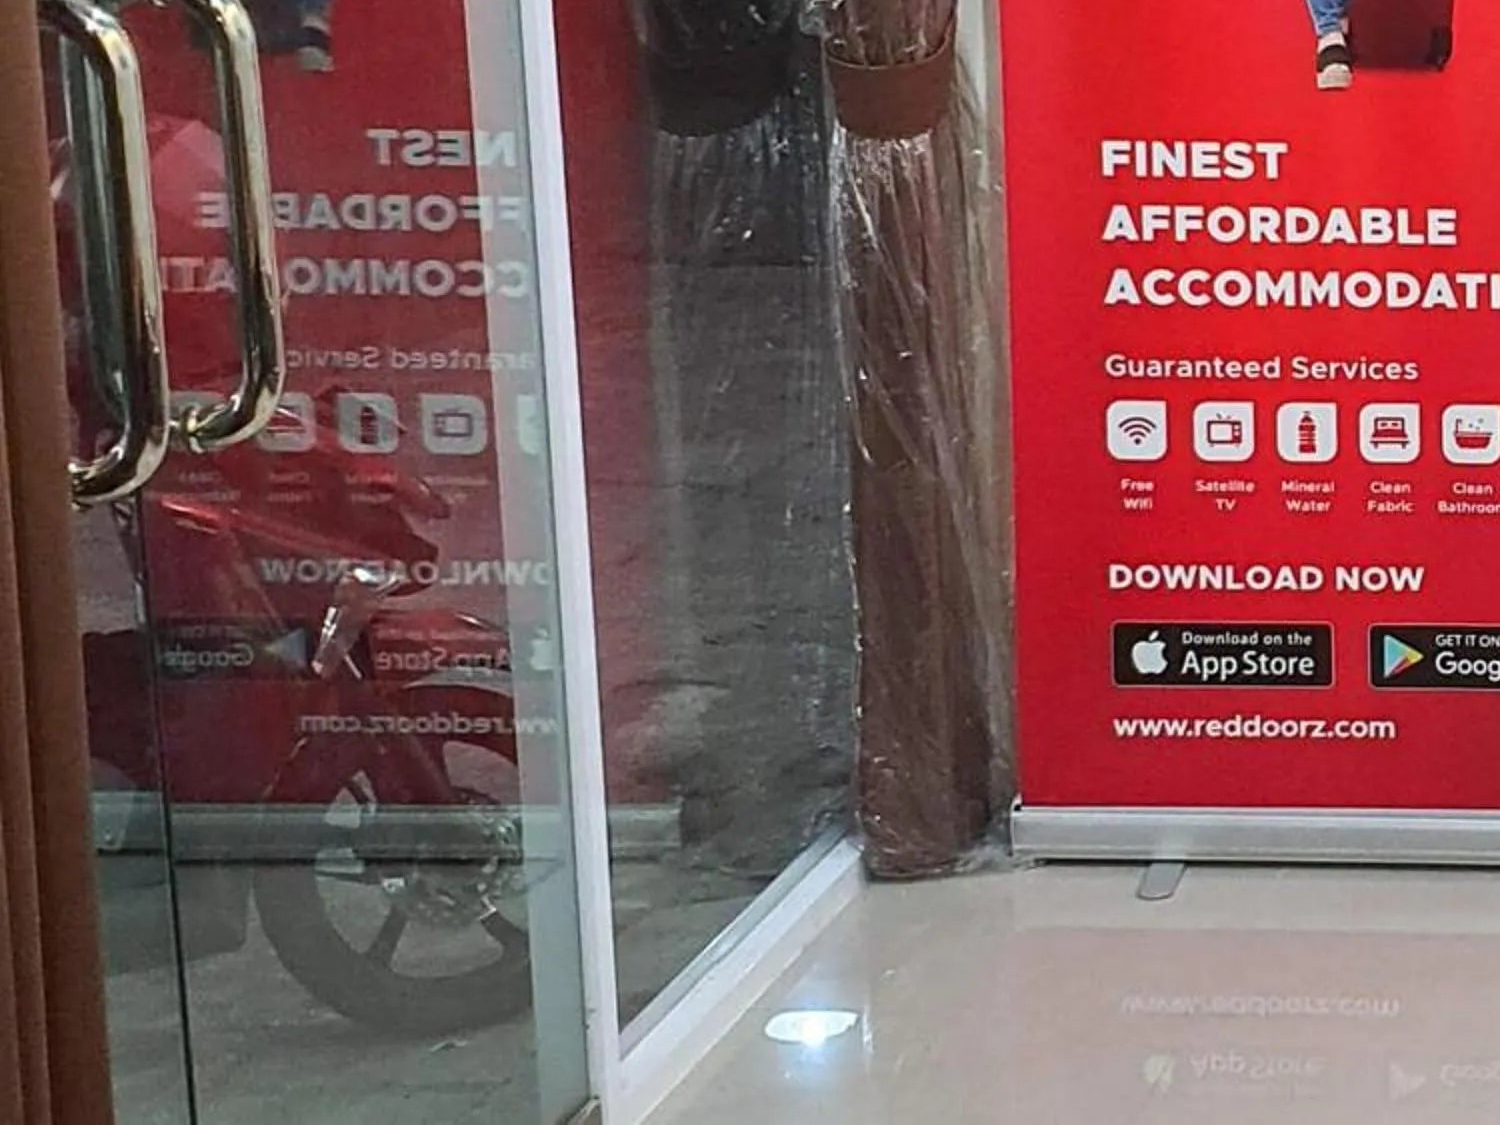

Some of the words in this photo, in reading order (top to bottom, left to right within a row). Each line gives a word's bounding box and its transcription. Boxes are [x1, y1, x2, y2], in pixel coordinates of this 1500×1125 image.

[1101, 140, 1289, 179] FINEST
[1102, 205, 1458, 246] AFFORDABLE
[1105, 356, 1282, 380] Guaranteed
[1291, 357, 1419, 381] Services
[1120, 478, 1155, 493] Free
[1195, 480, 1255, 493] Satellite
[1280, 480, 1335, 494] Mineral
[1369, 481, 1412, 495] Clean
[1452, 482, 1494, 496] Clean
[1214, 498, 1237, 511] TV
[1285, 499, 1332, 513] Water
[1366, 499, 1415, 514] Fabric
[1107, 563, 1325, 592] DOWNLOAD
[1335, 566, 1425, 593] NOW
[1181, 631, 1260, 646] Download
[1263, 634, 1283, 646] on
[1286, 632, 1313, 646] the
[1434, 634, 1461, 647] GET
[1464, 634, 1476, 647] IT
[1181, 651, 1238, 682] App
[1242, 651, 1316, 677] Store
[1112, 714, 1397, 739] www.reddoorz.com
